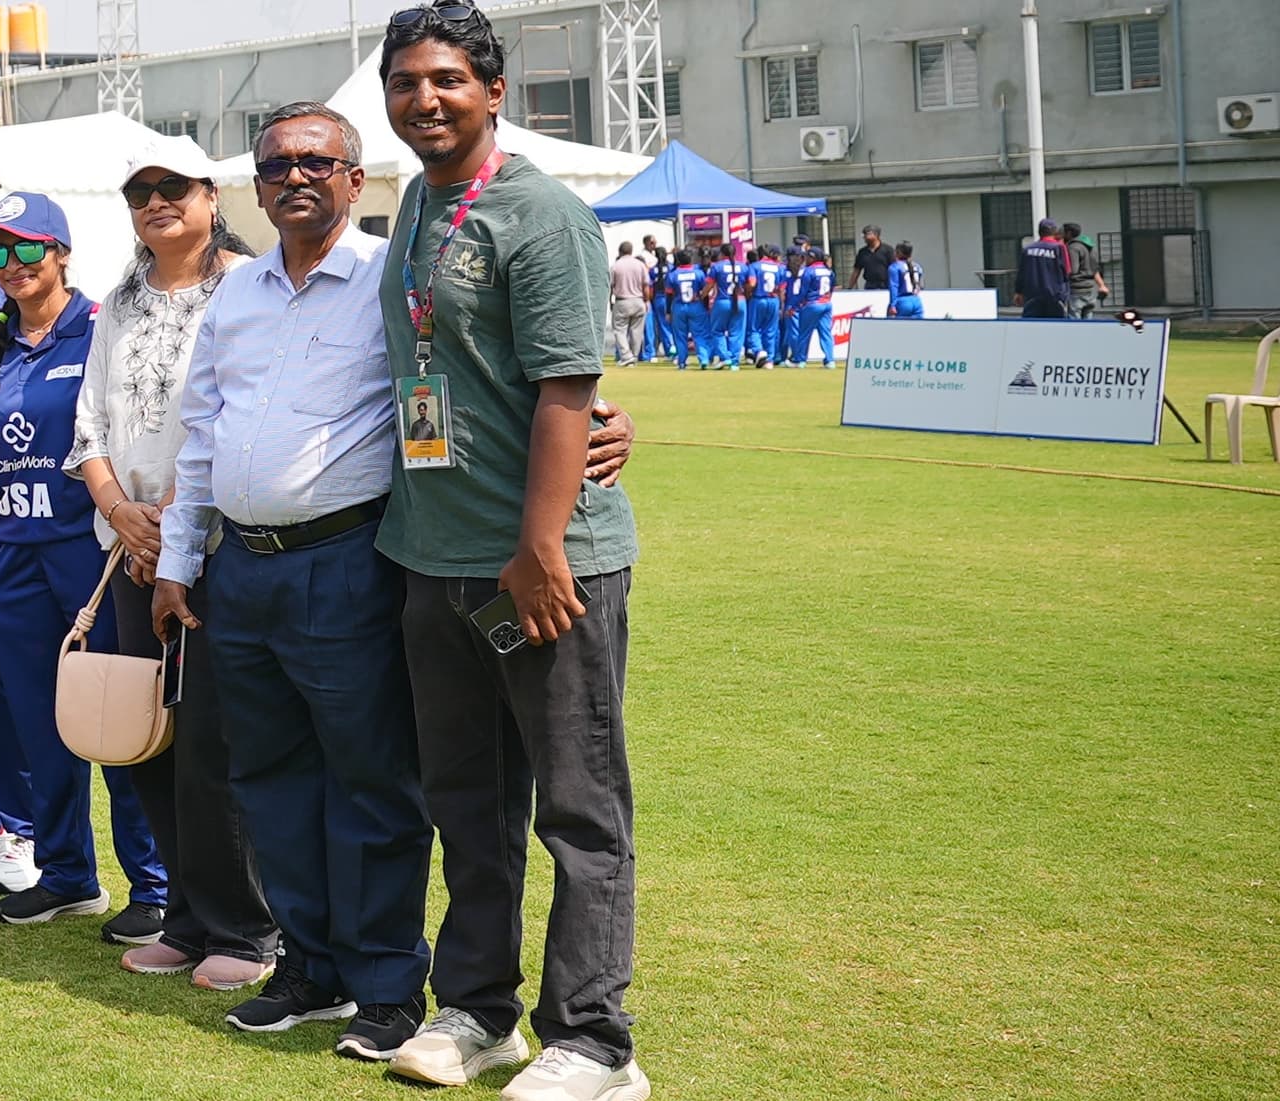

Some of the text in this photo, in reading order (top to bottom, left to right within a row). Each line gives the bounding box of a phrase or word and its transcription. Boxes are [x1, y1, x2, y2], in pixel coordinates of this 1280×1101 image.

[1027, 247, 1057, 259] NEPAL
[680, 280, 694, 303] 5
[1042, 365, 1151, 386] PRESIDENCY
[917, 380, 936, 390] Live
[936, 381, 967, 392] better.
[1041, 386, 1146, 400] UNIVERSITY
